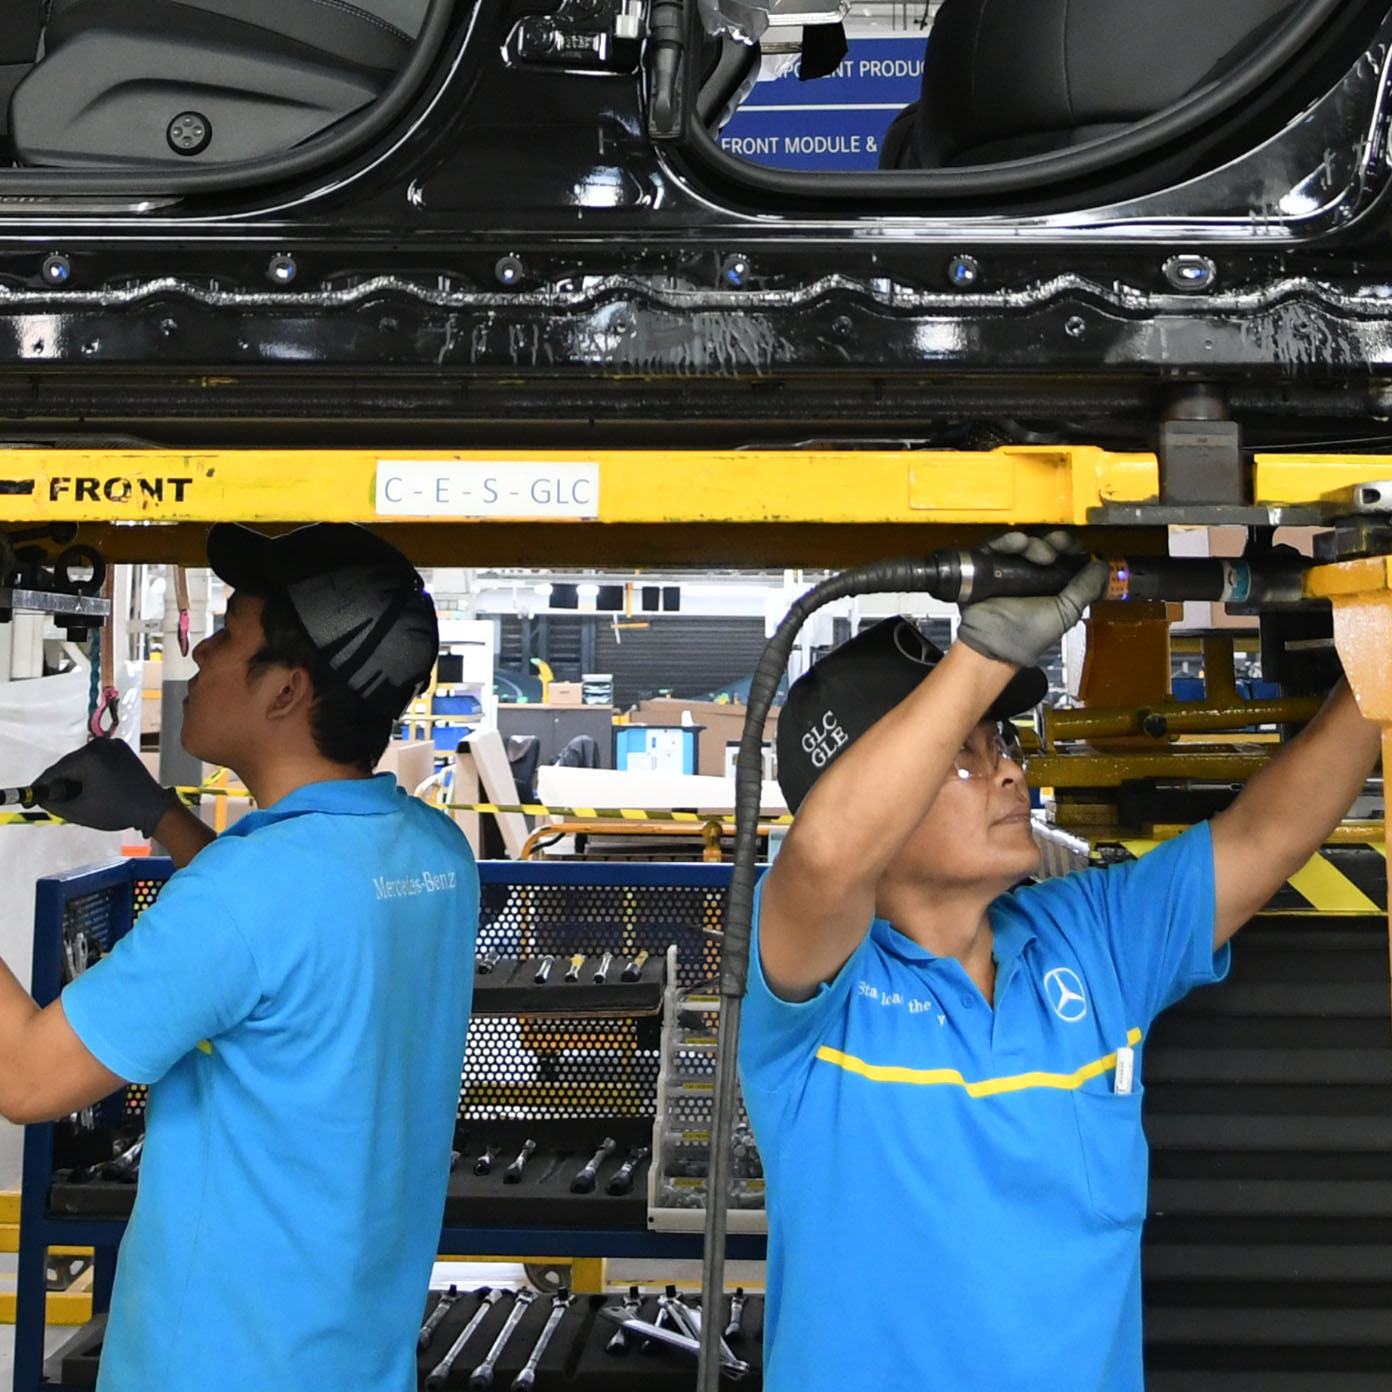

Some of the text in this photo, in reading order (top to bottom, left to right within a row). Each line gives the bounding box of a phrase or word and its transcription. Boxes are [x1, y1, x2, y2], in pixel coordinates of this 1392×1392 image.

[721, 135, 878, 154] FRONT MODULE &
[49, 476, 193, 505] FRONT
[530, 478, 591, 504] GLC
[801, 710, 837, 753] GLC
[811, 726, 849, 767] GLE
[908, 998, 932, 1014] the
